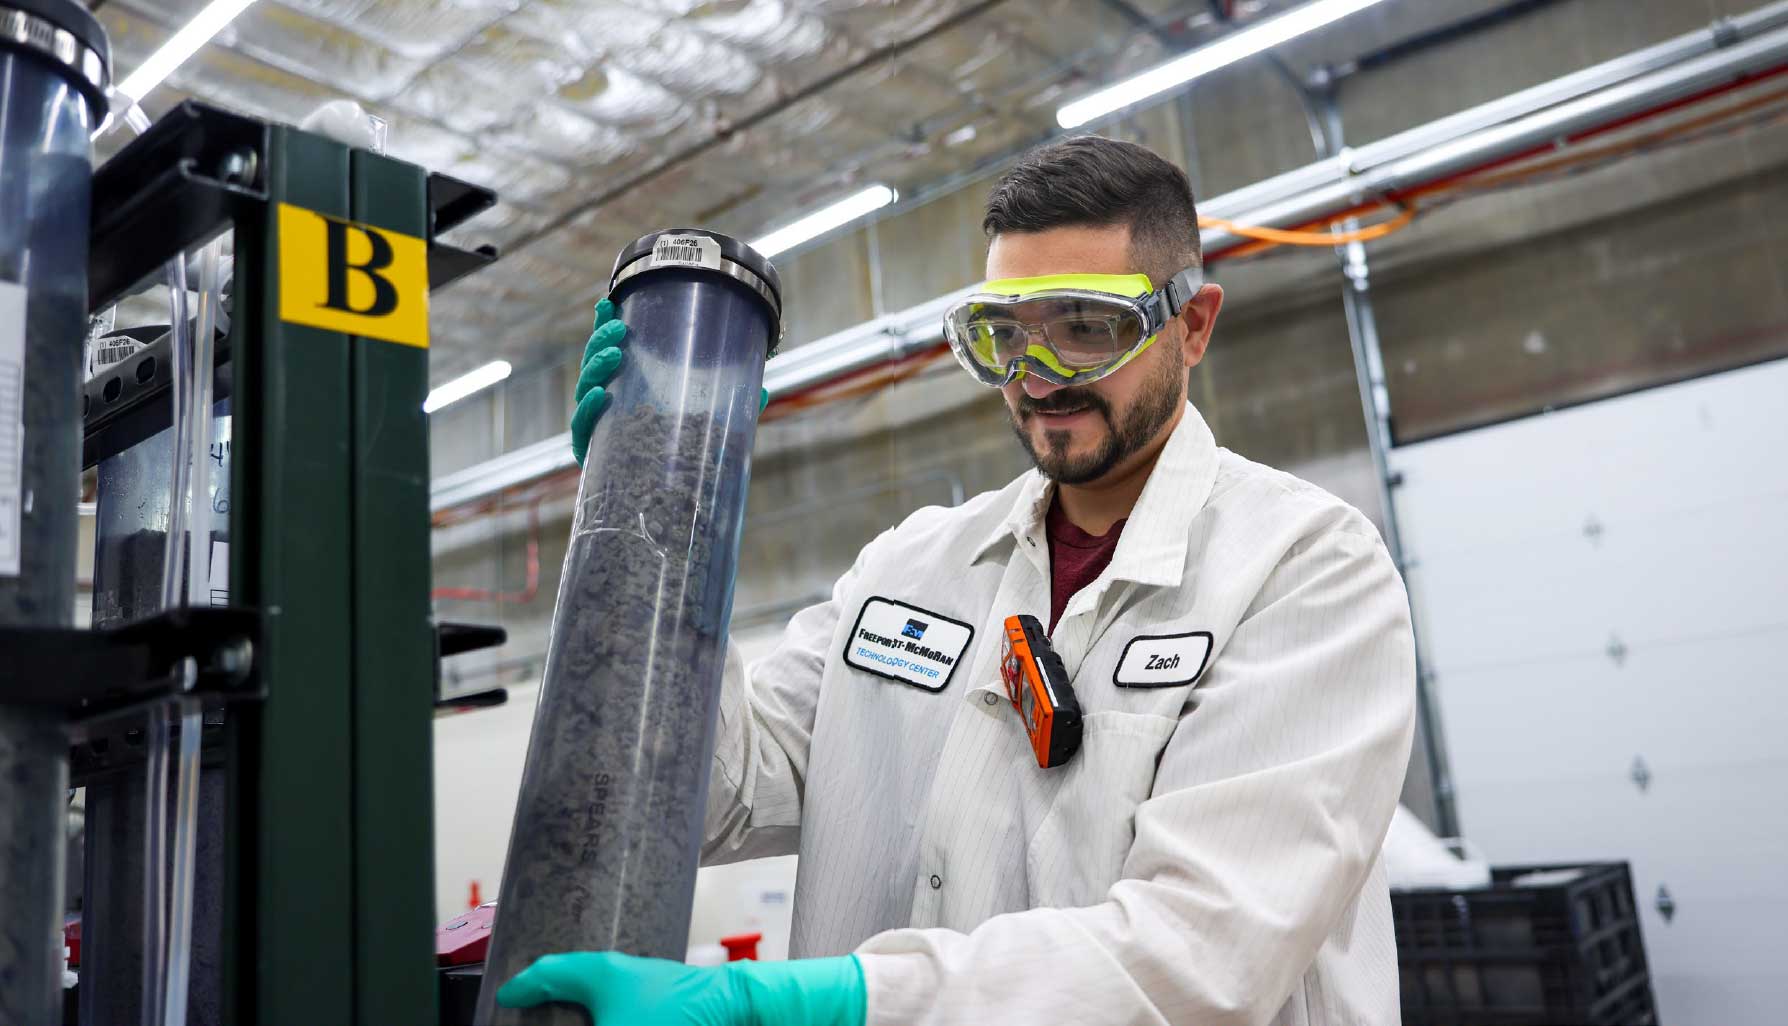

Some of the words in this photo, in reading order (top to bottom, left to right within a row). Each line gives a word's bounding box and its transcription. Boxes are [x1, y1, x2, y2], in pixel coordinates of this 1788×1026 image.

[314, 213, 399, 318] B
[856, 647, 910, 668] TECHNOLOGY
[908, 663, 940, 679] CENTER
[1144, 653, 1181, 670] Zach
[579, 773, 609, 866] SPEARS
